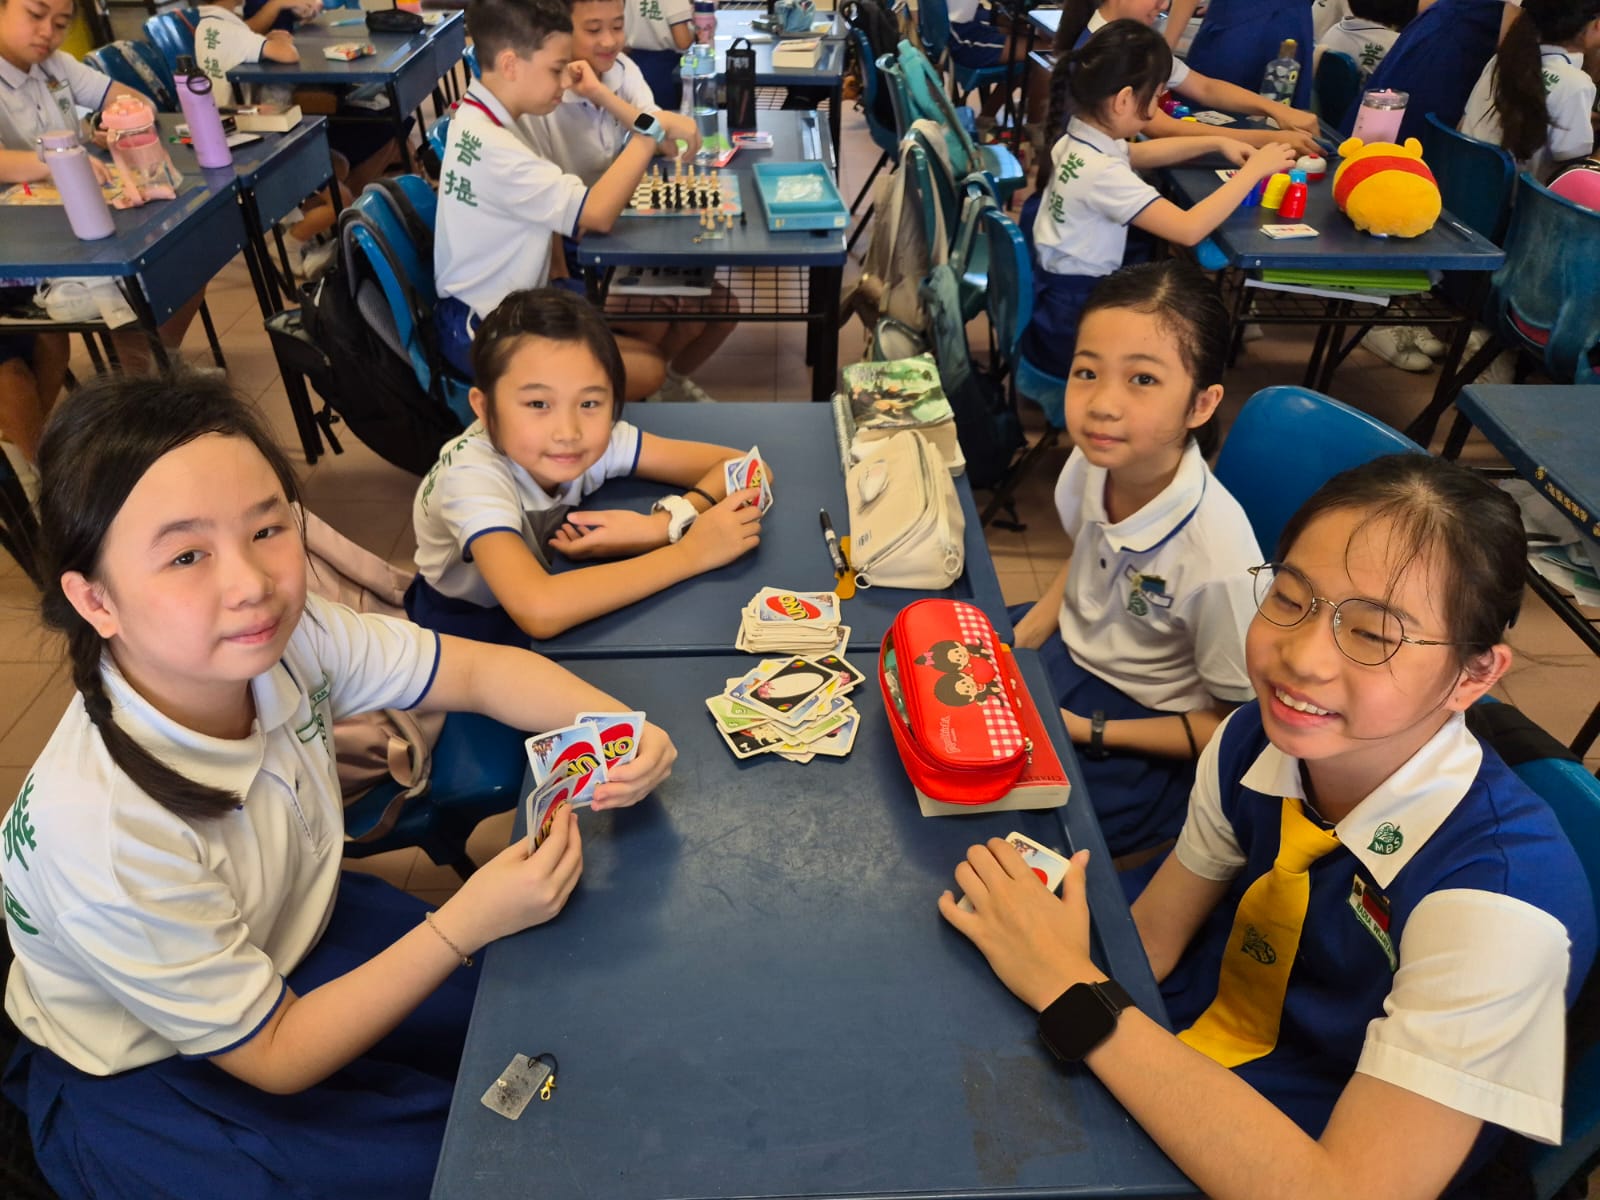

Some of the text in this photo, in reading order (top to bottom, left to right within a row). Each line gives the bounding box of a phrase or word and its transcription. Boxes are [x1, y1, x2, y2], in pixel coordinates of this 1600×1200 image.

[445, 129, 482, 207] 菩提
[779, 593, 808, 621] UNO
[602, 737, 634, 760] NO
[566, 753, 601, 777] UN
[1374, 836, 1400, 854] MBS
